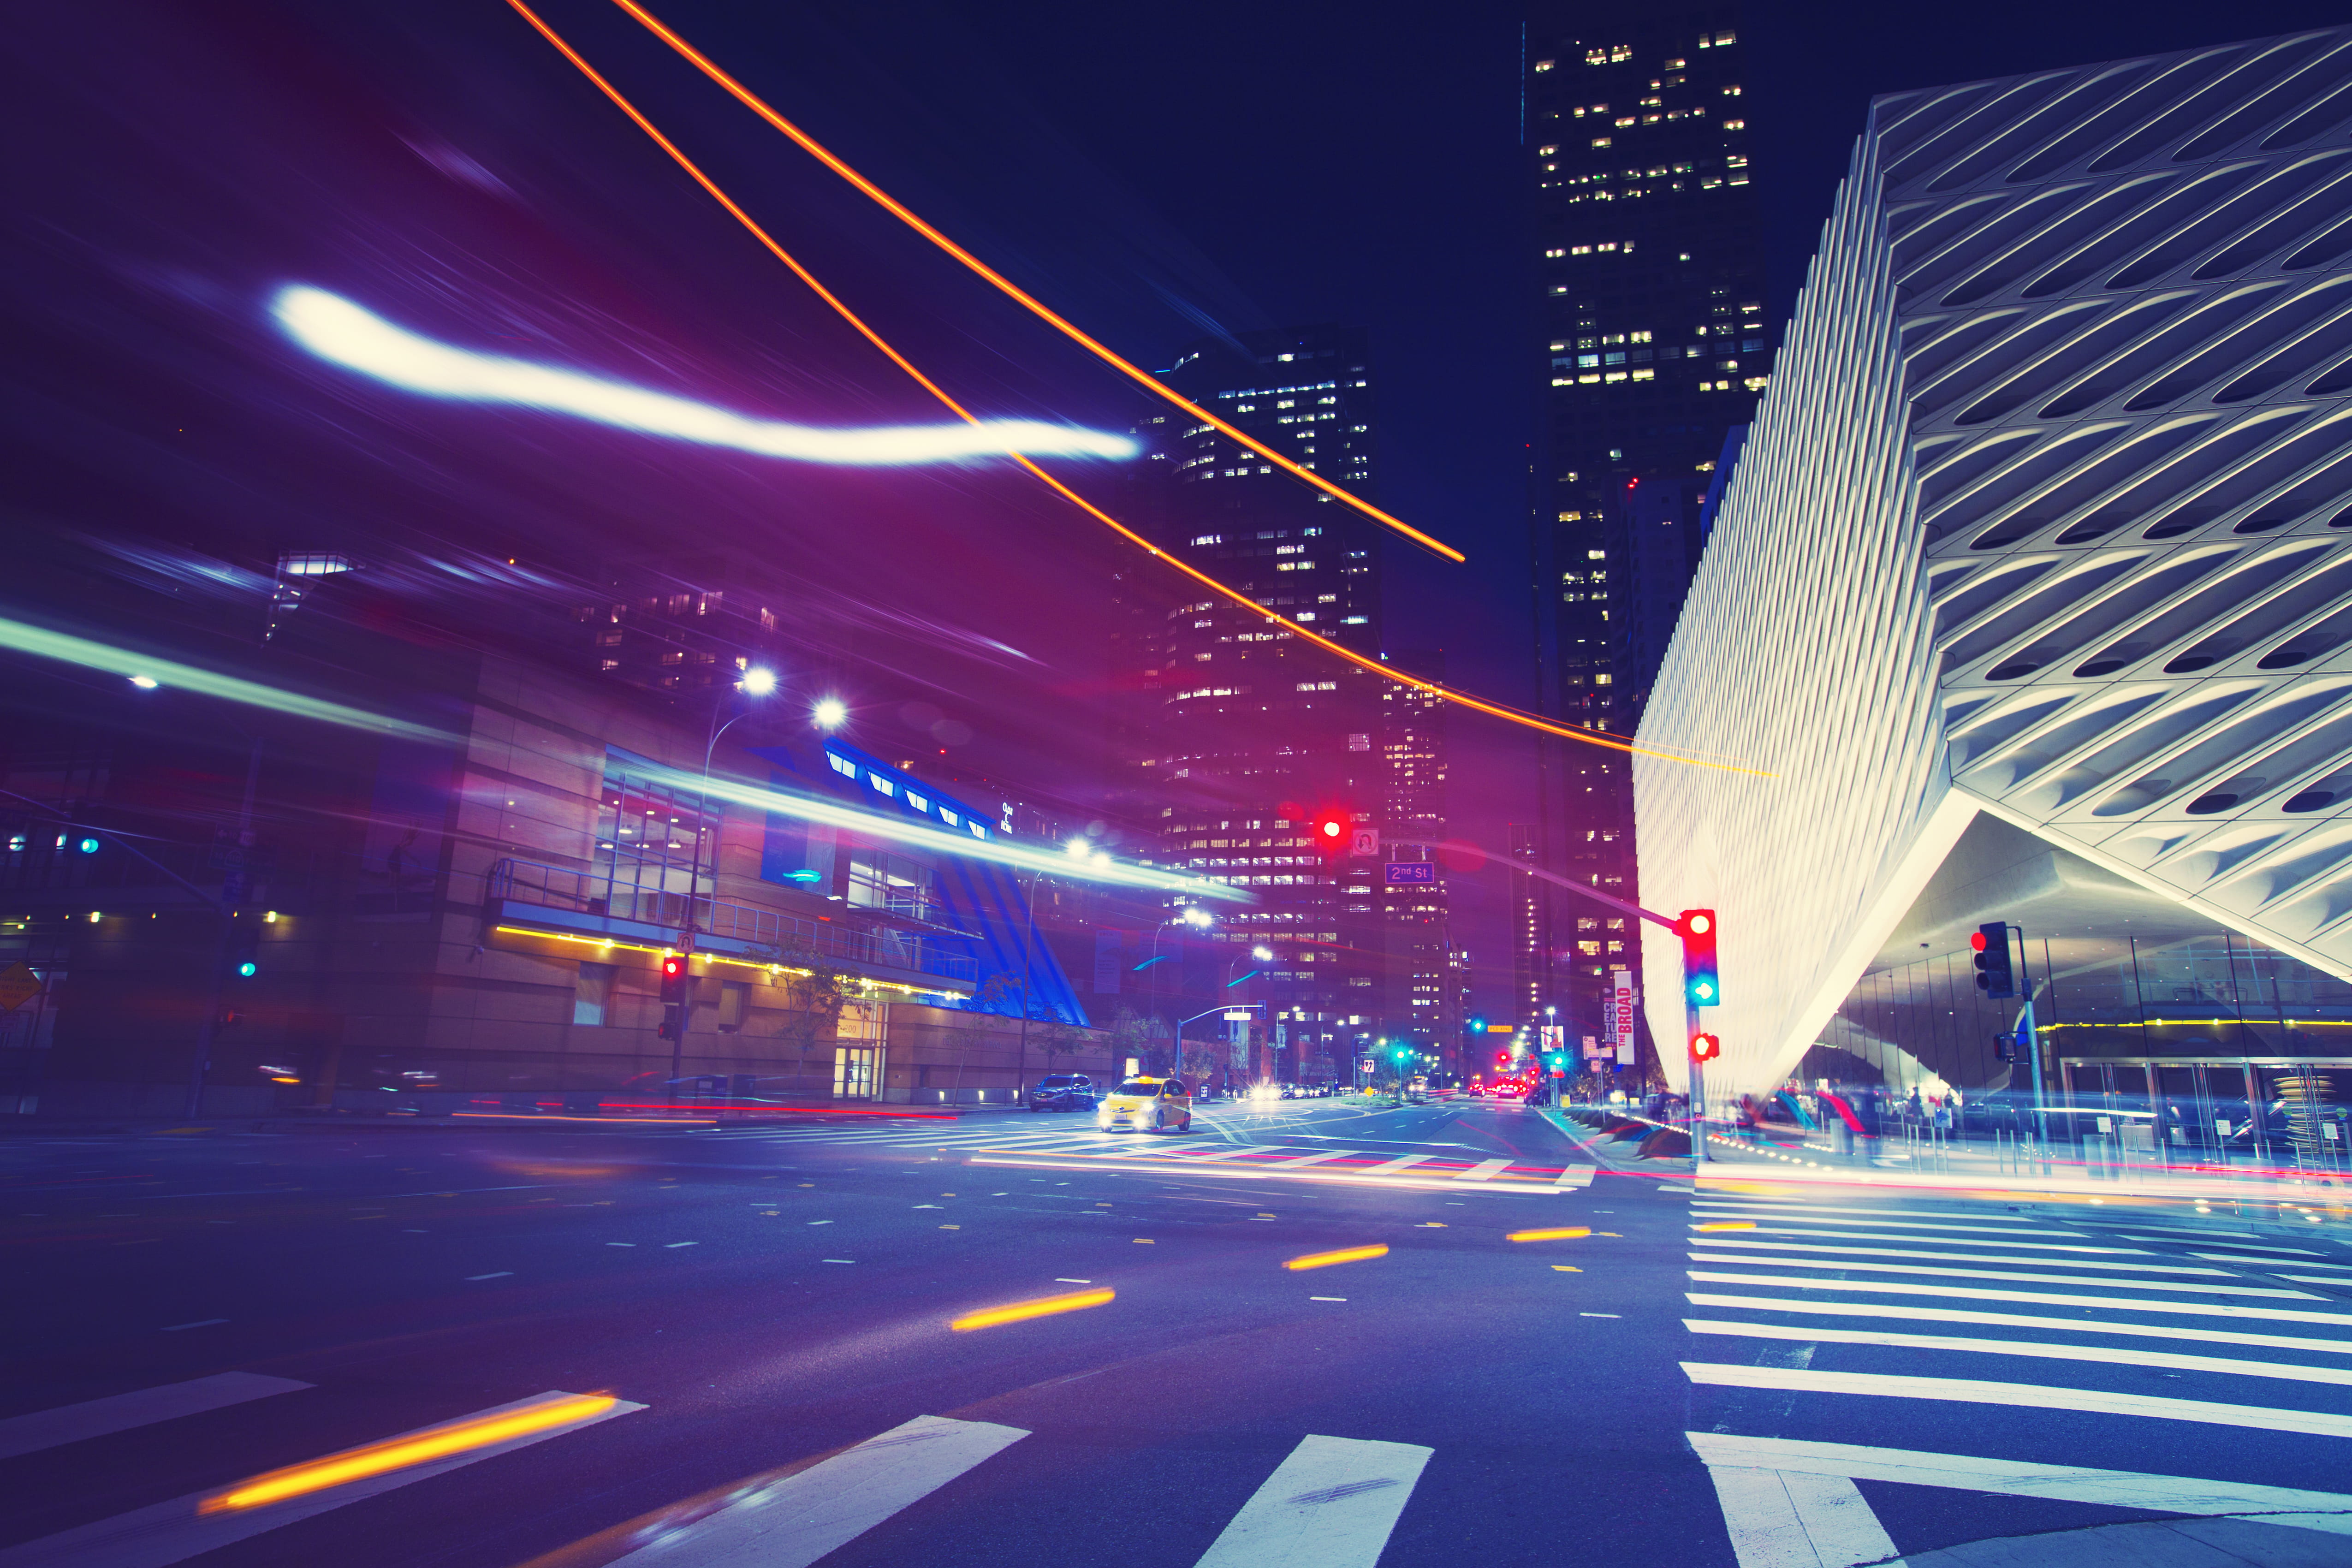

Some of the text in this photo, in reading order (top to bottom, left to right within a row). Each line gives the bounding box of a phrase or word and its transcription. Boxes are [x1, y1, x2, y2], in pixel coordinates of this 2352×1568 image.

[1392, 867, 1427, 879] 2nd St
[1617, 987, 1633, 1033] BROAD
